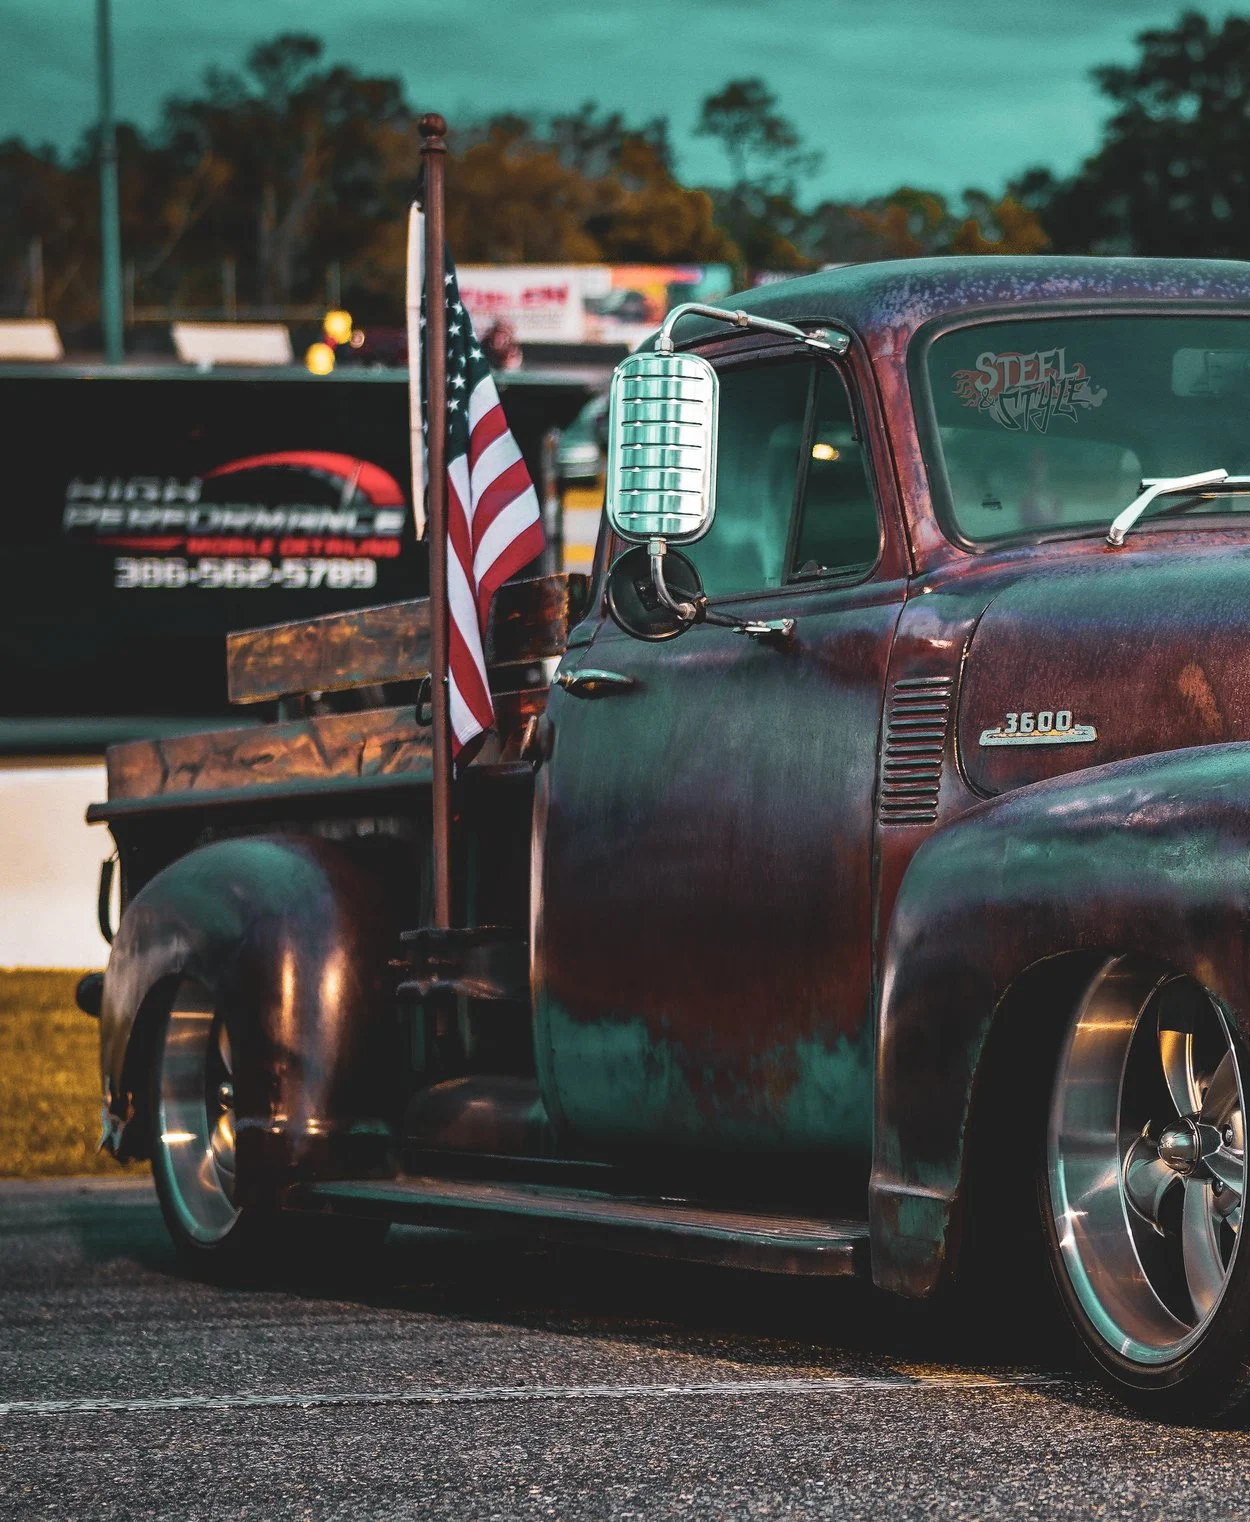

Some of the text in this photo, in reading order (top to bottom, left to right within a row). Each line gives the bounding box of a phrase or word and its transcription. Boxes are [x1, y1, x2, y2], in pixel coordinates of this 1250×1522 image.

[975, 347, 1080, 392] STEEL
[998, 375, 1091, 434] STYLE
[66, 474, 203, 500] HIGH
[63, 502, 406, 535] PERFORMANCE
[1004, 710, 1072, 734] 3600
